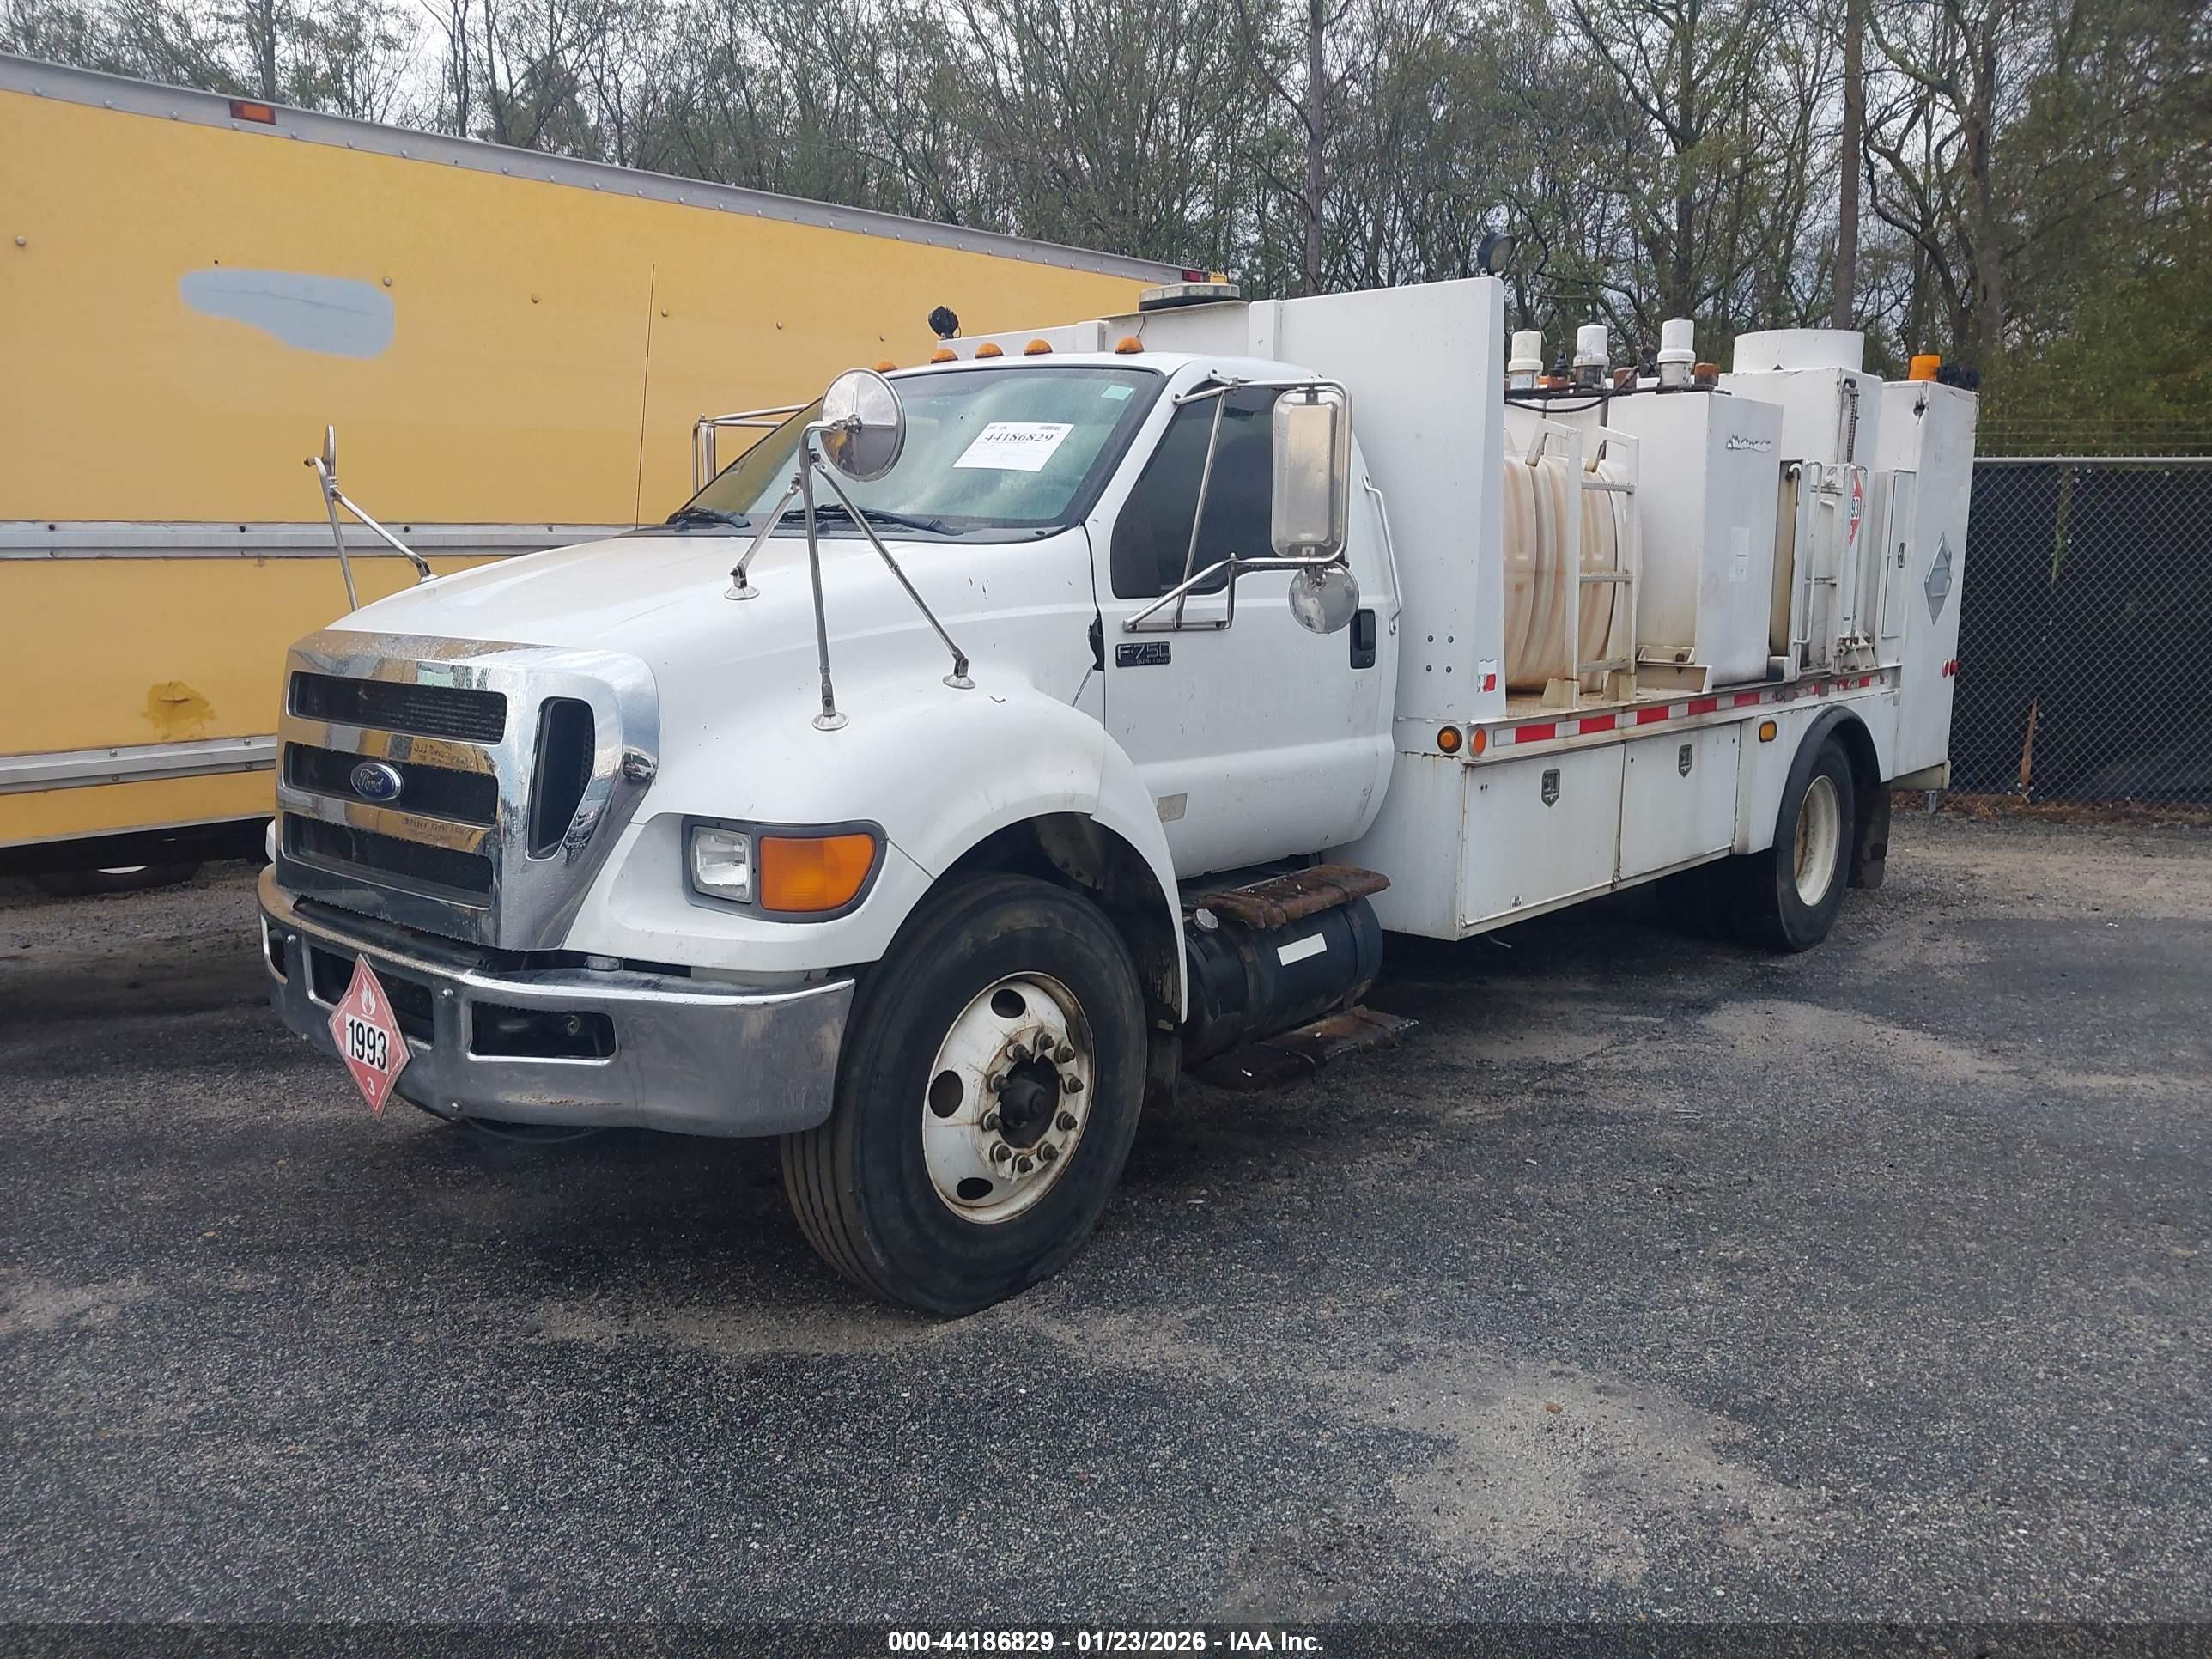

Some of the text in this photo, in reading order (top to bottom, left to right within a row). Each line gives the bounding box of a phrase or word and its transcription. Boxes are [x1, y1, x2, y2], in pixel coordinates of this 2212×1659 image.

[984, 432, 1054, 442] 44186829
[357, 768, 384, 793] Ford
[349, 1019, 387, 1070] 1993
[367, 1076, 376, 1097] 3
